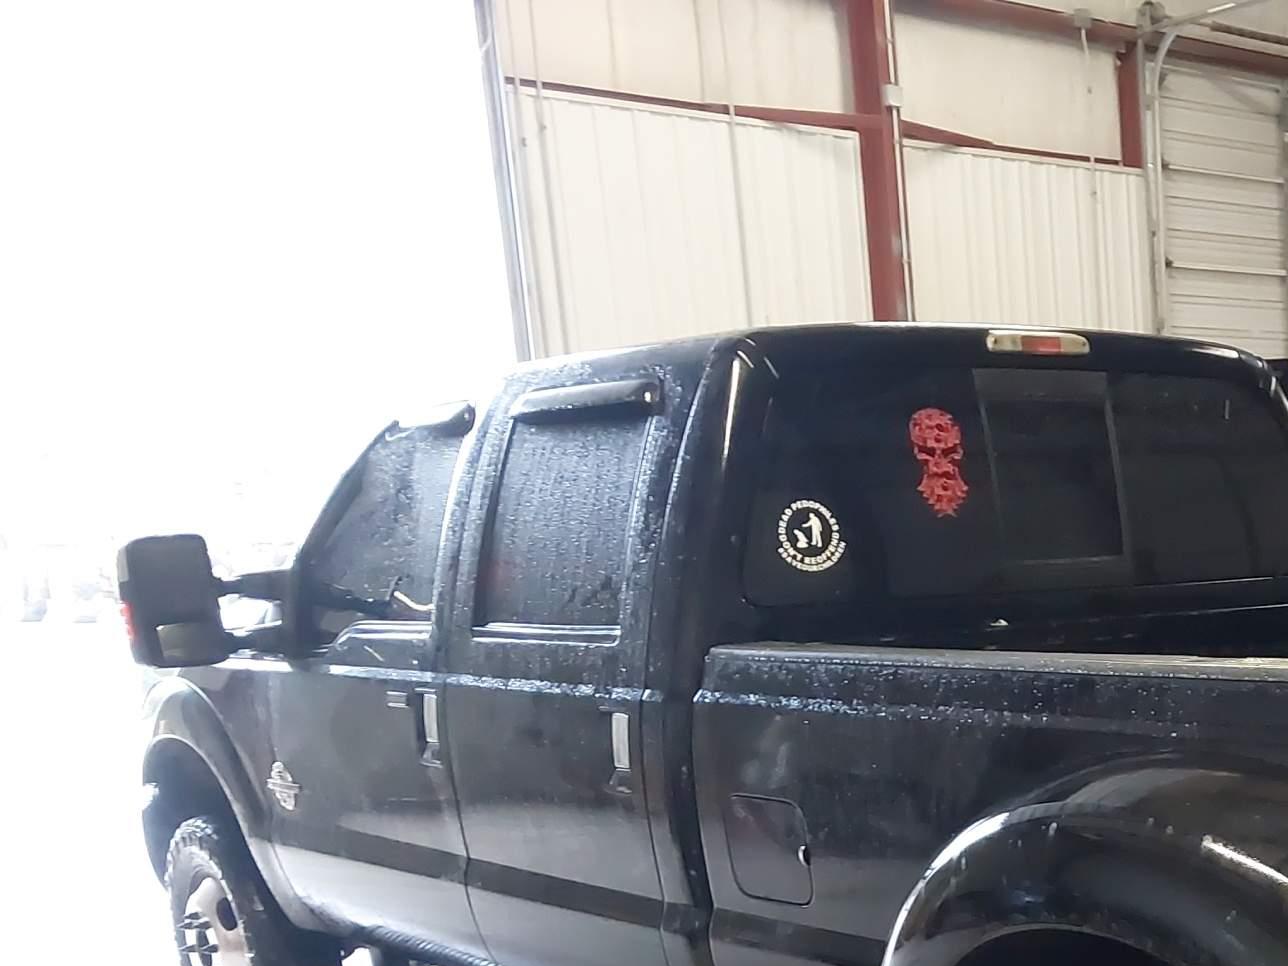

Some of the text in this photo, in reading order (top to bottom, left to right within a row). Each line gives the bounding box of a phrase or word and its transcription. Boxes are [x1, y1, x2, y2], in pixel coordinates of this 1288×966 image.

[778, 508, 792, 534] DEAD
[778, 532, 840, 565] DON'T REOFFEND
